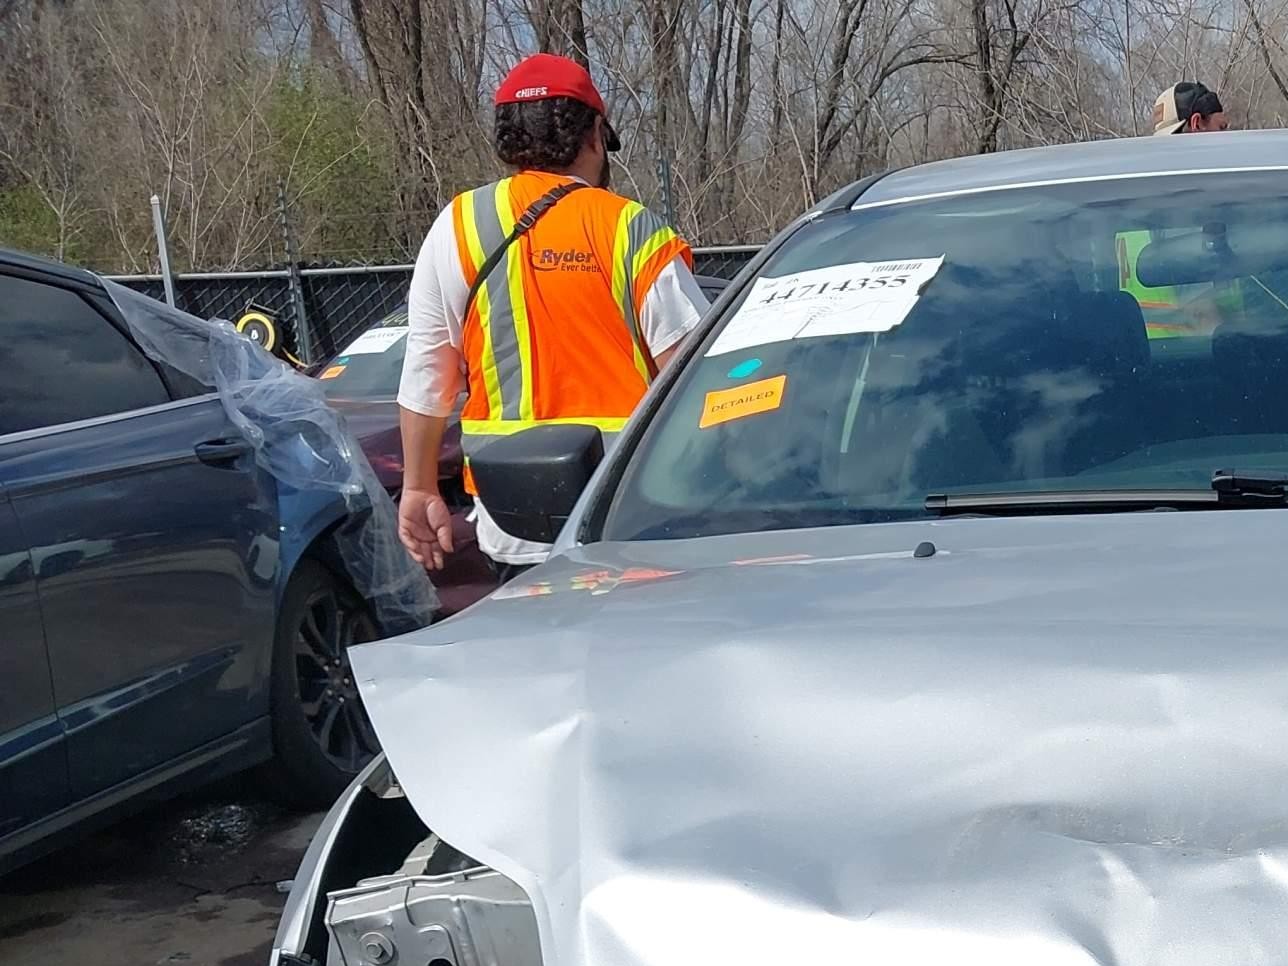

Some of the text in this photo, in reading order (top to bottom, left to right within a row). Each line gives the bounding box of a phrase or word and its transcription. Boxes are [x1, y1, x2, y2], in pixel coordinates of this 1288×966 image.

[515, 86, 548, 98] CHIEFS
[540, 248, 592, 266] Ryder
[560, 263, 579, 272] Ever
[760, 274, 911, 304] 44714355
[711, 390, 774, 413] DETAILED
